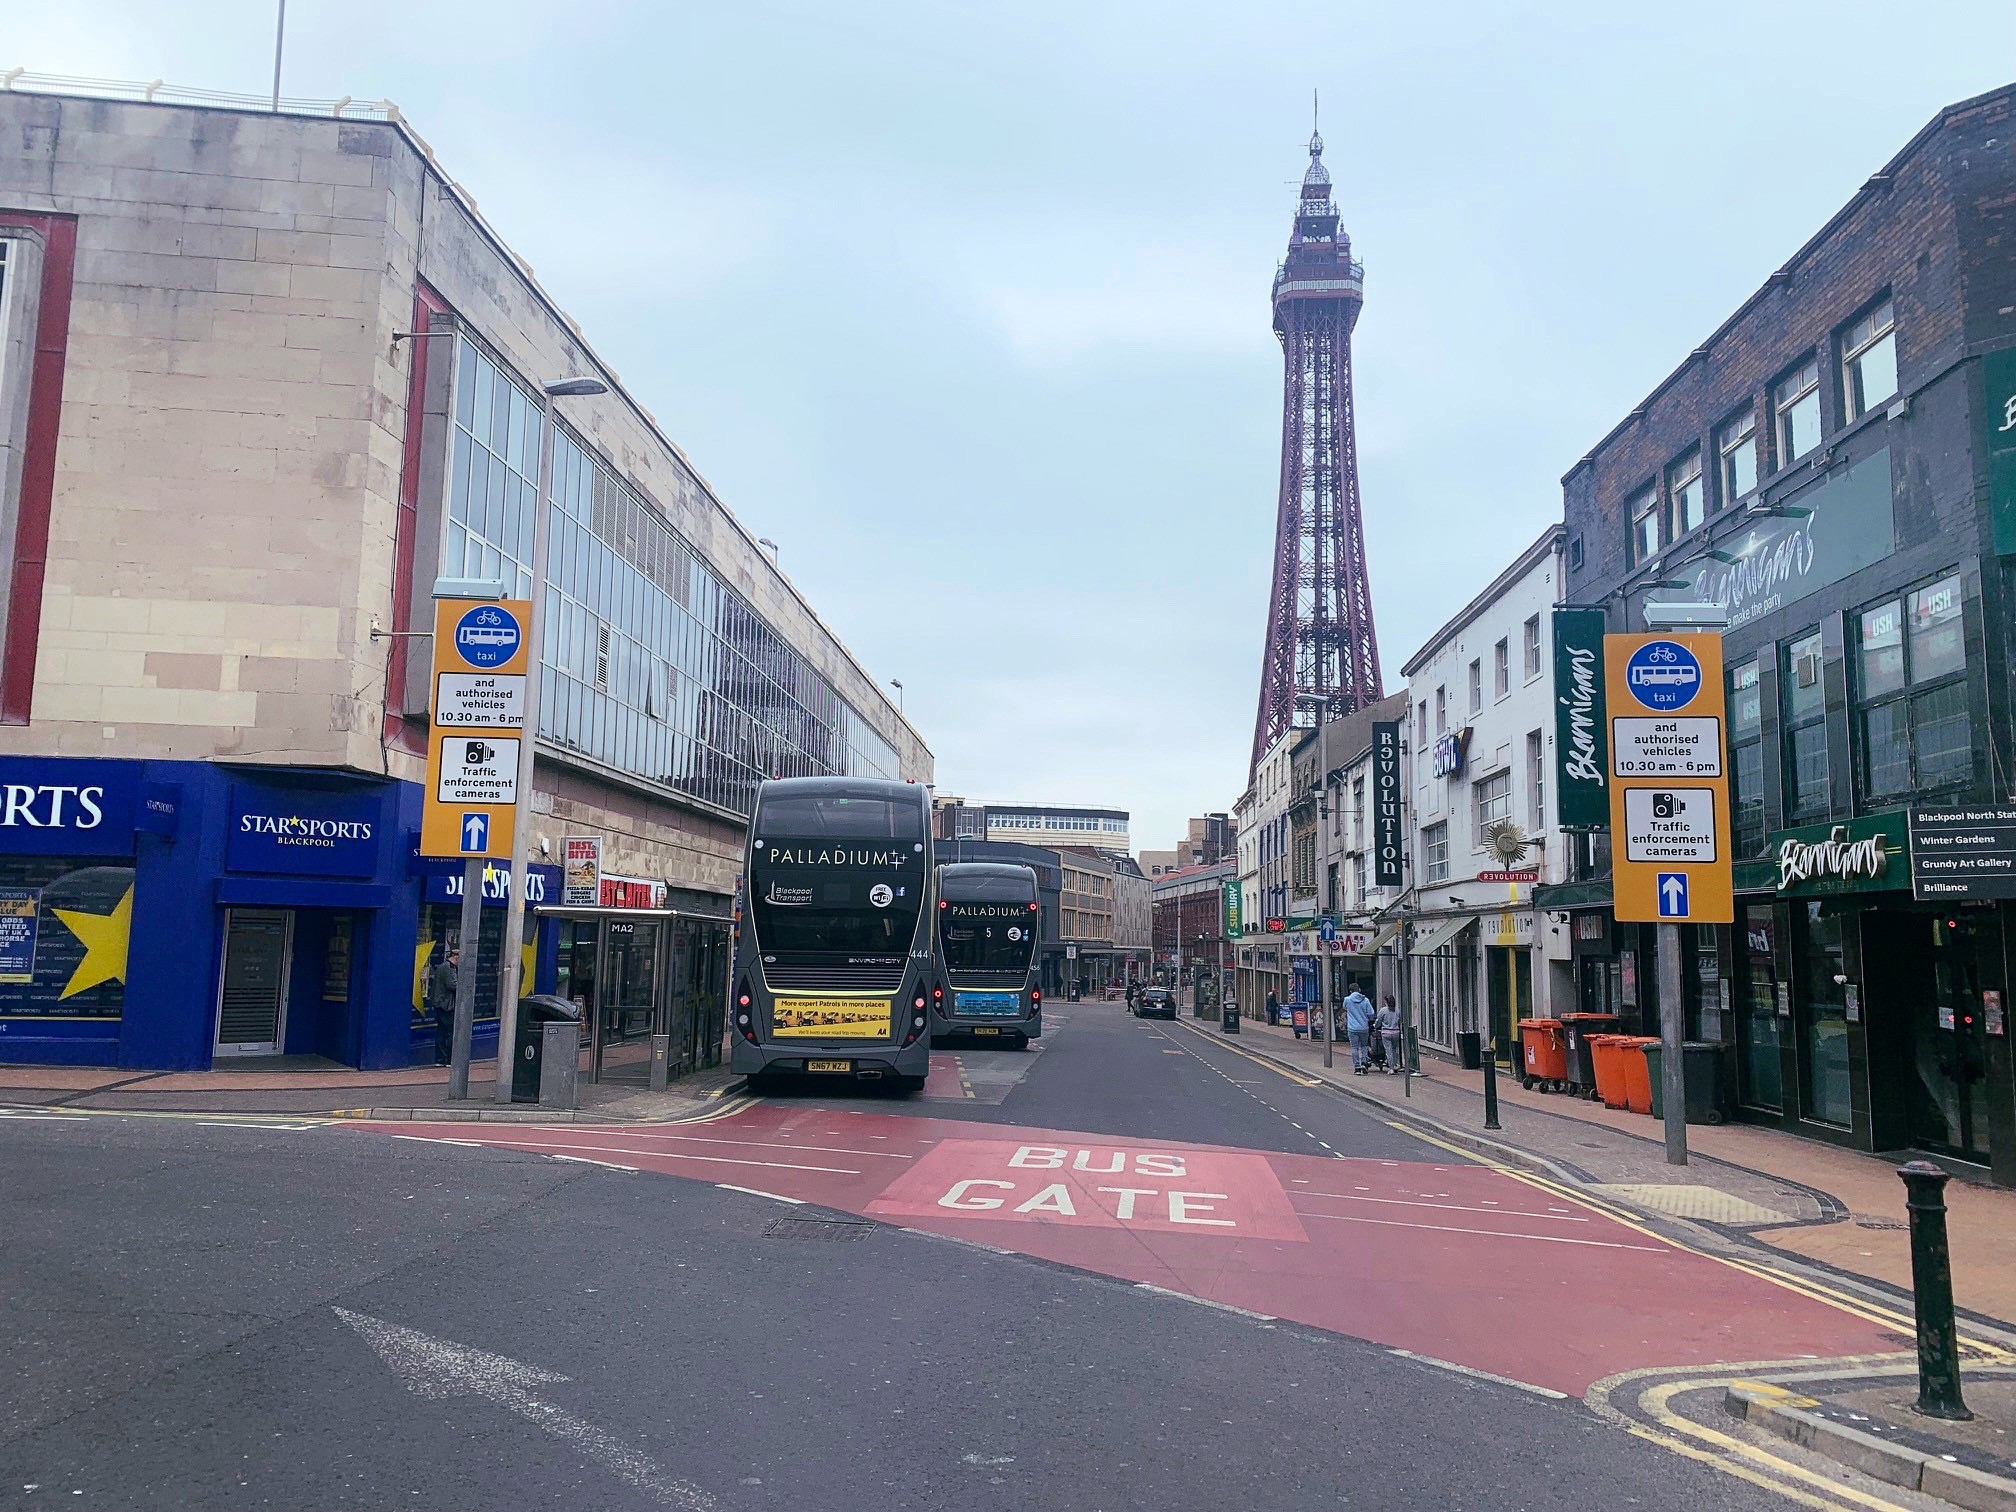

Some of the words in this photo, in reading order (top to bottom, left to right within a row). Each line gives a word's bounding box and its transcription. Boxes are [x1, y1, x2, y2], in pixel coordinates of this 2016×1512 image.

[1733, 609, 1750, 625] make
[1751, 602, 1762, 617] the
[1763, 592, 1782, 614] party
[477, 652, 496, 660] taxi
[475, 679, 495, 687] and
[455, 689, 513, 699] authorised
[1654, 693, 1676, 702] taxi
[462, 700, 506, 709] vehicles
[441, 712, 472, 722] 10.30
[499, 714, 506, 723] 6
[508, 716, 523, 724] pm
[1655, 723, 1677, 732] and
[1634, 734, 1699, 744] authorised
[1642, 747, 1692, 756] vehicles
[462, 767, 497, 776] Traffic
[1620, 761, 1656, 771] 10.30
[1686, 761, 1694, 771] 6
[1697, 763, 1715, 773] pm
[444, 778, 513, 788] enforcement
[455, 790, 500, 799] cameras
[0, 785, 103, 828] RTS
[1919, 812, 1964, 823] Blackpool
[1967, 811, 1995, 820] North
[1650, 822, 1690, 832] Traffic
[278, 836, 335, 847] BLACKPOOL
[1632, 834, 1710, 844] enforcement
[1920, 836, 1951, 845] Winter
[1952, 835, 1996, 845] Gardens
[568, 841, 593, 850] BEST
[568, 851, 597, 859] BITES
[1645, 848, 1697, 856] cameras
[770, 849, 888, 866] PALLADIUM
[1922, 860, 1957, 871] Grundy
[1960, 859, 1976, 868] Art
[1977, 858, 2012, 869] Gallery
[775, 887, 813, 896] Blackpool
[1924, 883, 1968, 892] Brilliance
[600, 879, 617, 907] EST
[775, 894, 812, 902] Transport
[952, 906, 1020, 917] PALLADIUM
[1229, 884, 1238, 929] SUBWAY
[611, 924, 634, 933] MA2
[986, 927, 992, 938] 5
[910, 950, 928, 959] 444
[798, 1000, 818, 1008] expert
[877, 1028, 887, 1036] AA
[811, 1061, 831, 1071] SN67
[832, 1061, 847, 1071] WZJ
[1007, 1146, 1187, 1178] BUS
[937, 1179, 1236, 1227] GATE
